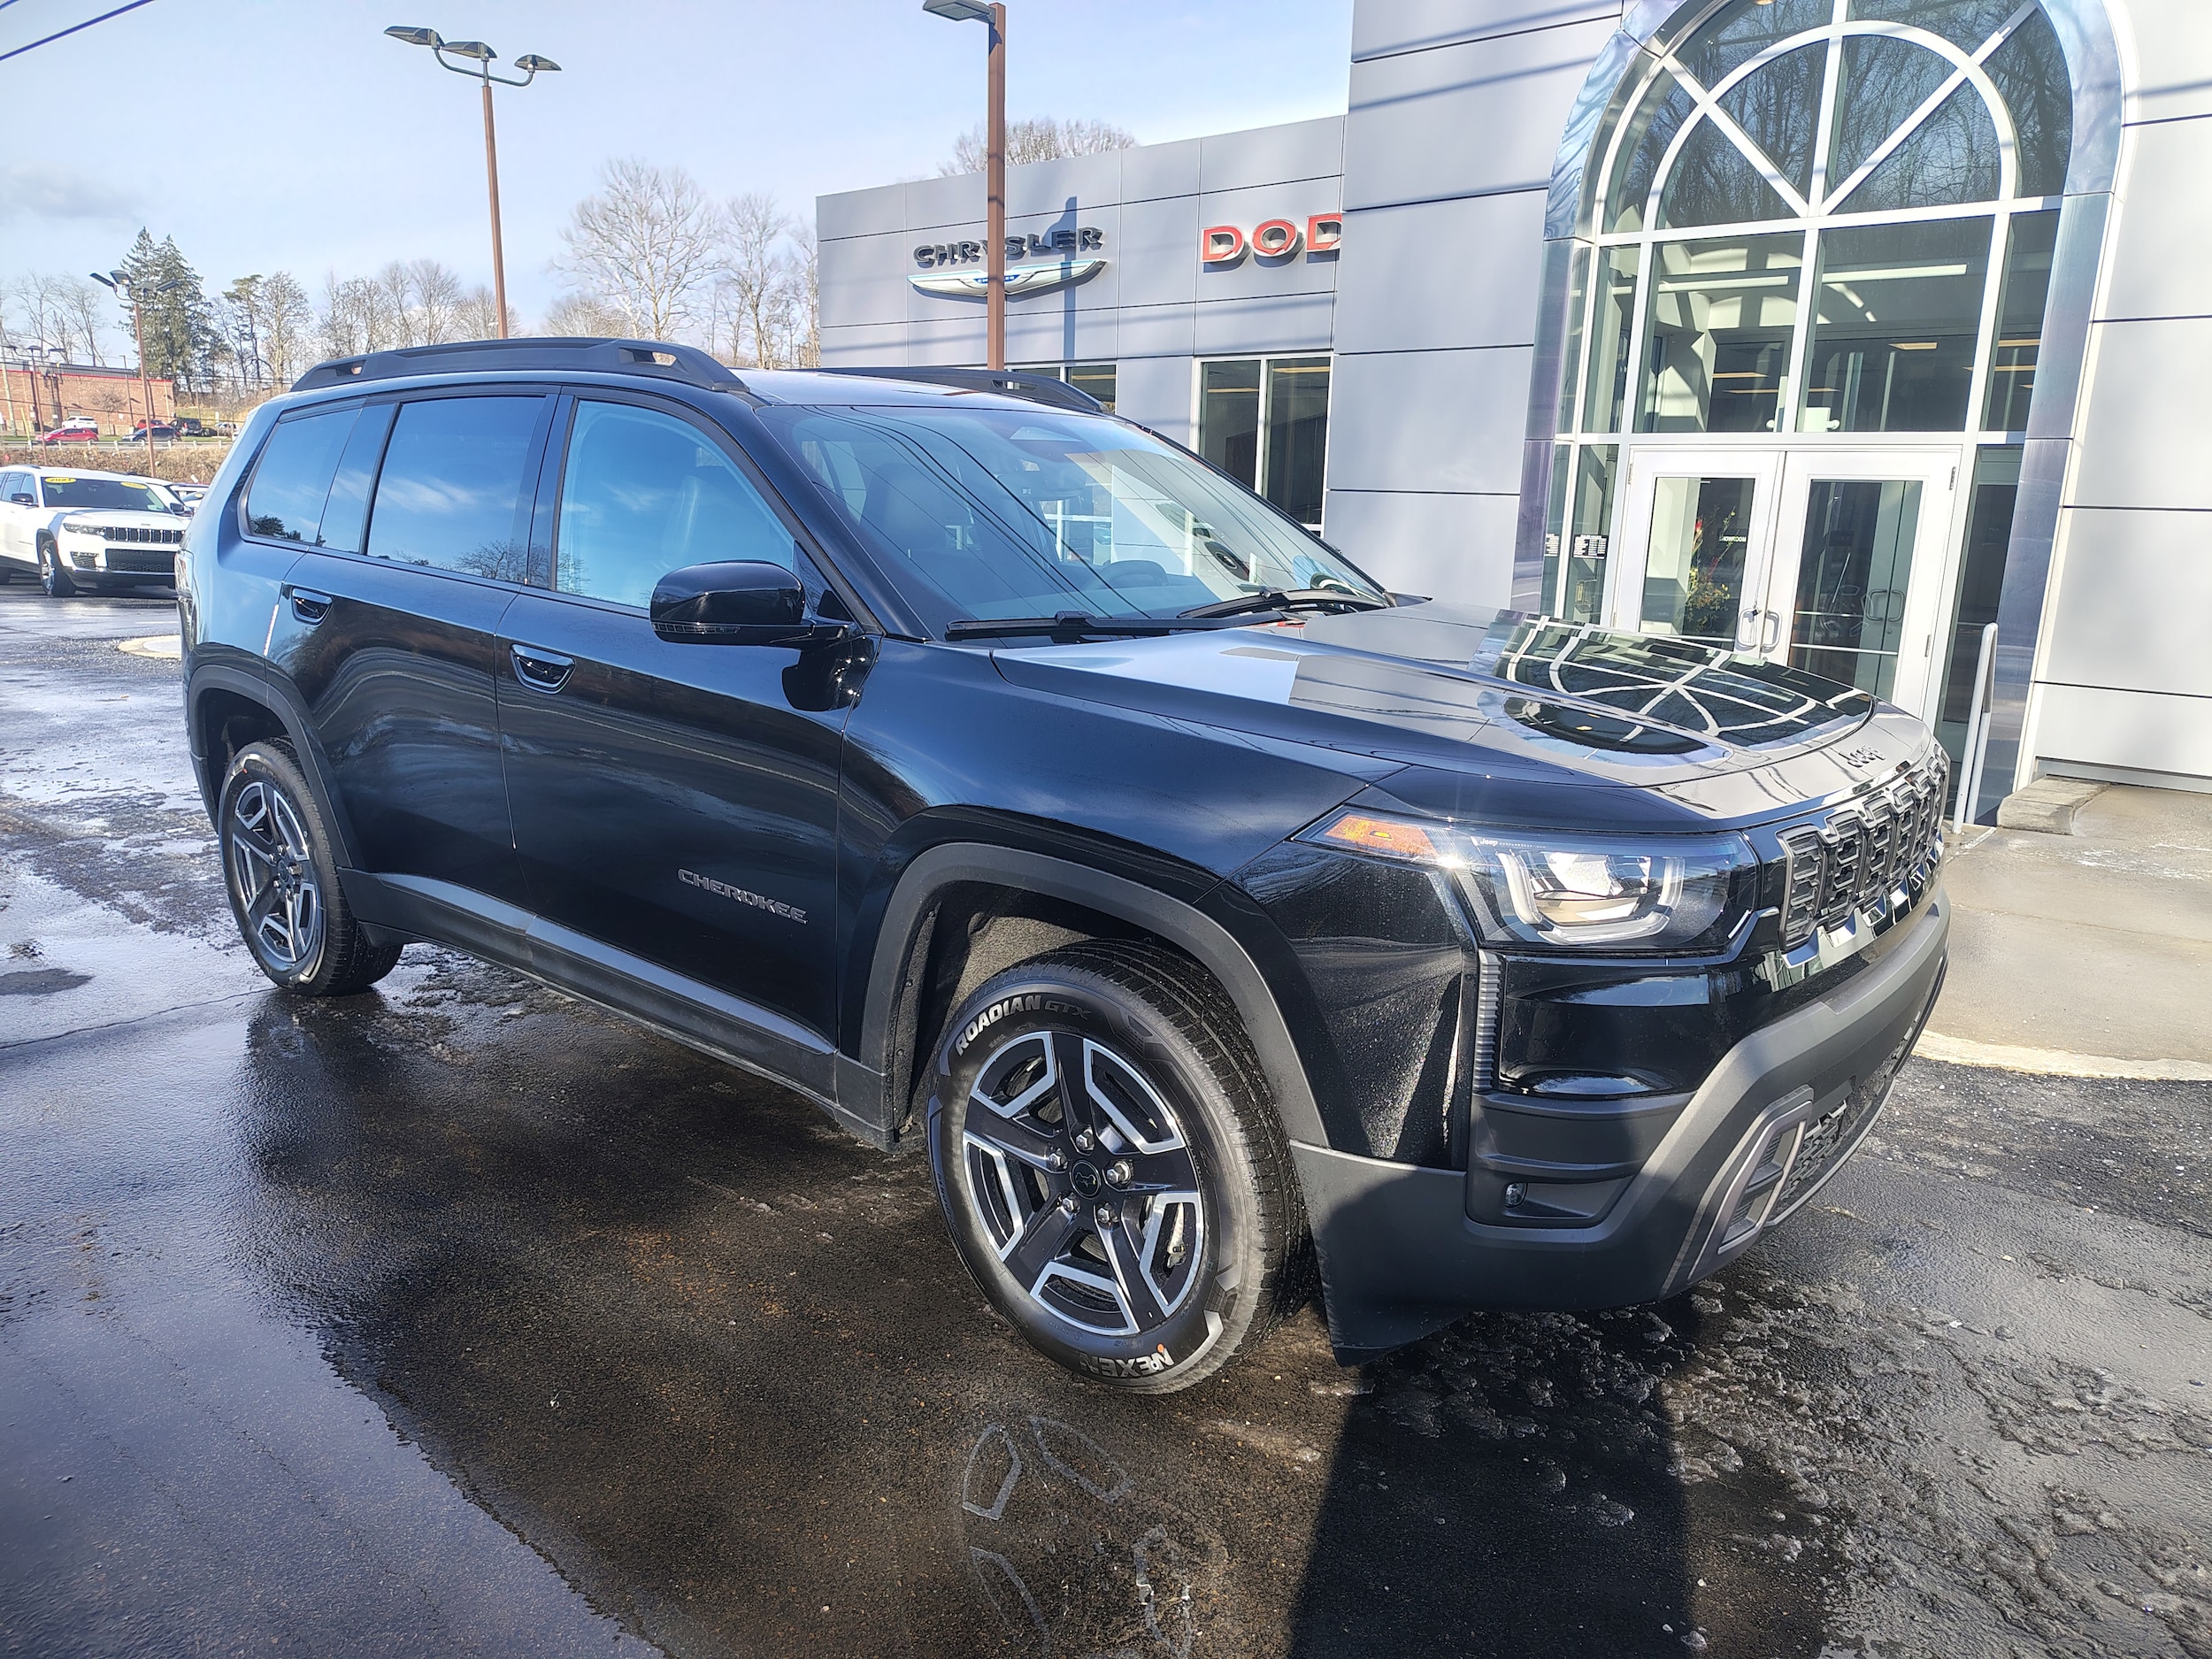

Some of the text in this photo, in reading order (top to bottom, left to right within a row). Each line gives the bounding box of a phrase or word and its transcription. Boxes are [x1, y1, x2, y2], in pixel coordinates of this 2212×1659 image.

[677, 868, 809, 925] CHEROKEE
[955, 995, 1092, 1056] ROADIAN GTX
[1078, 1347, 1175, 1378] NEXEN
